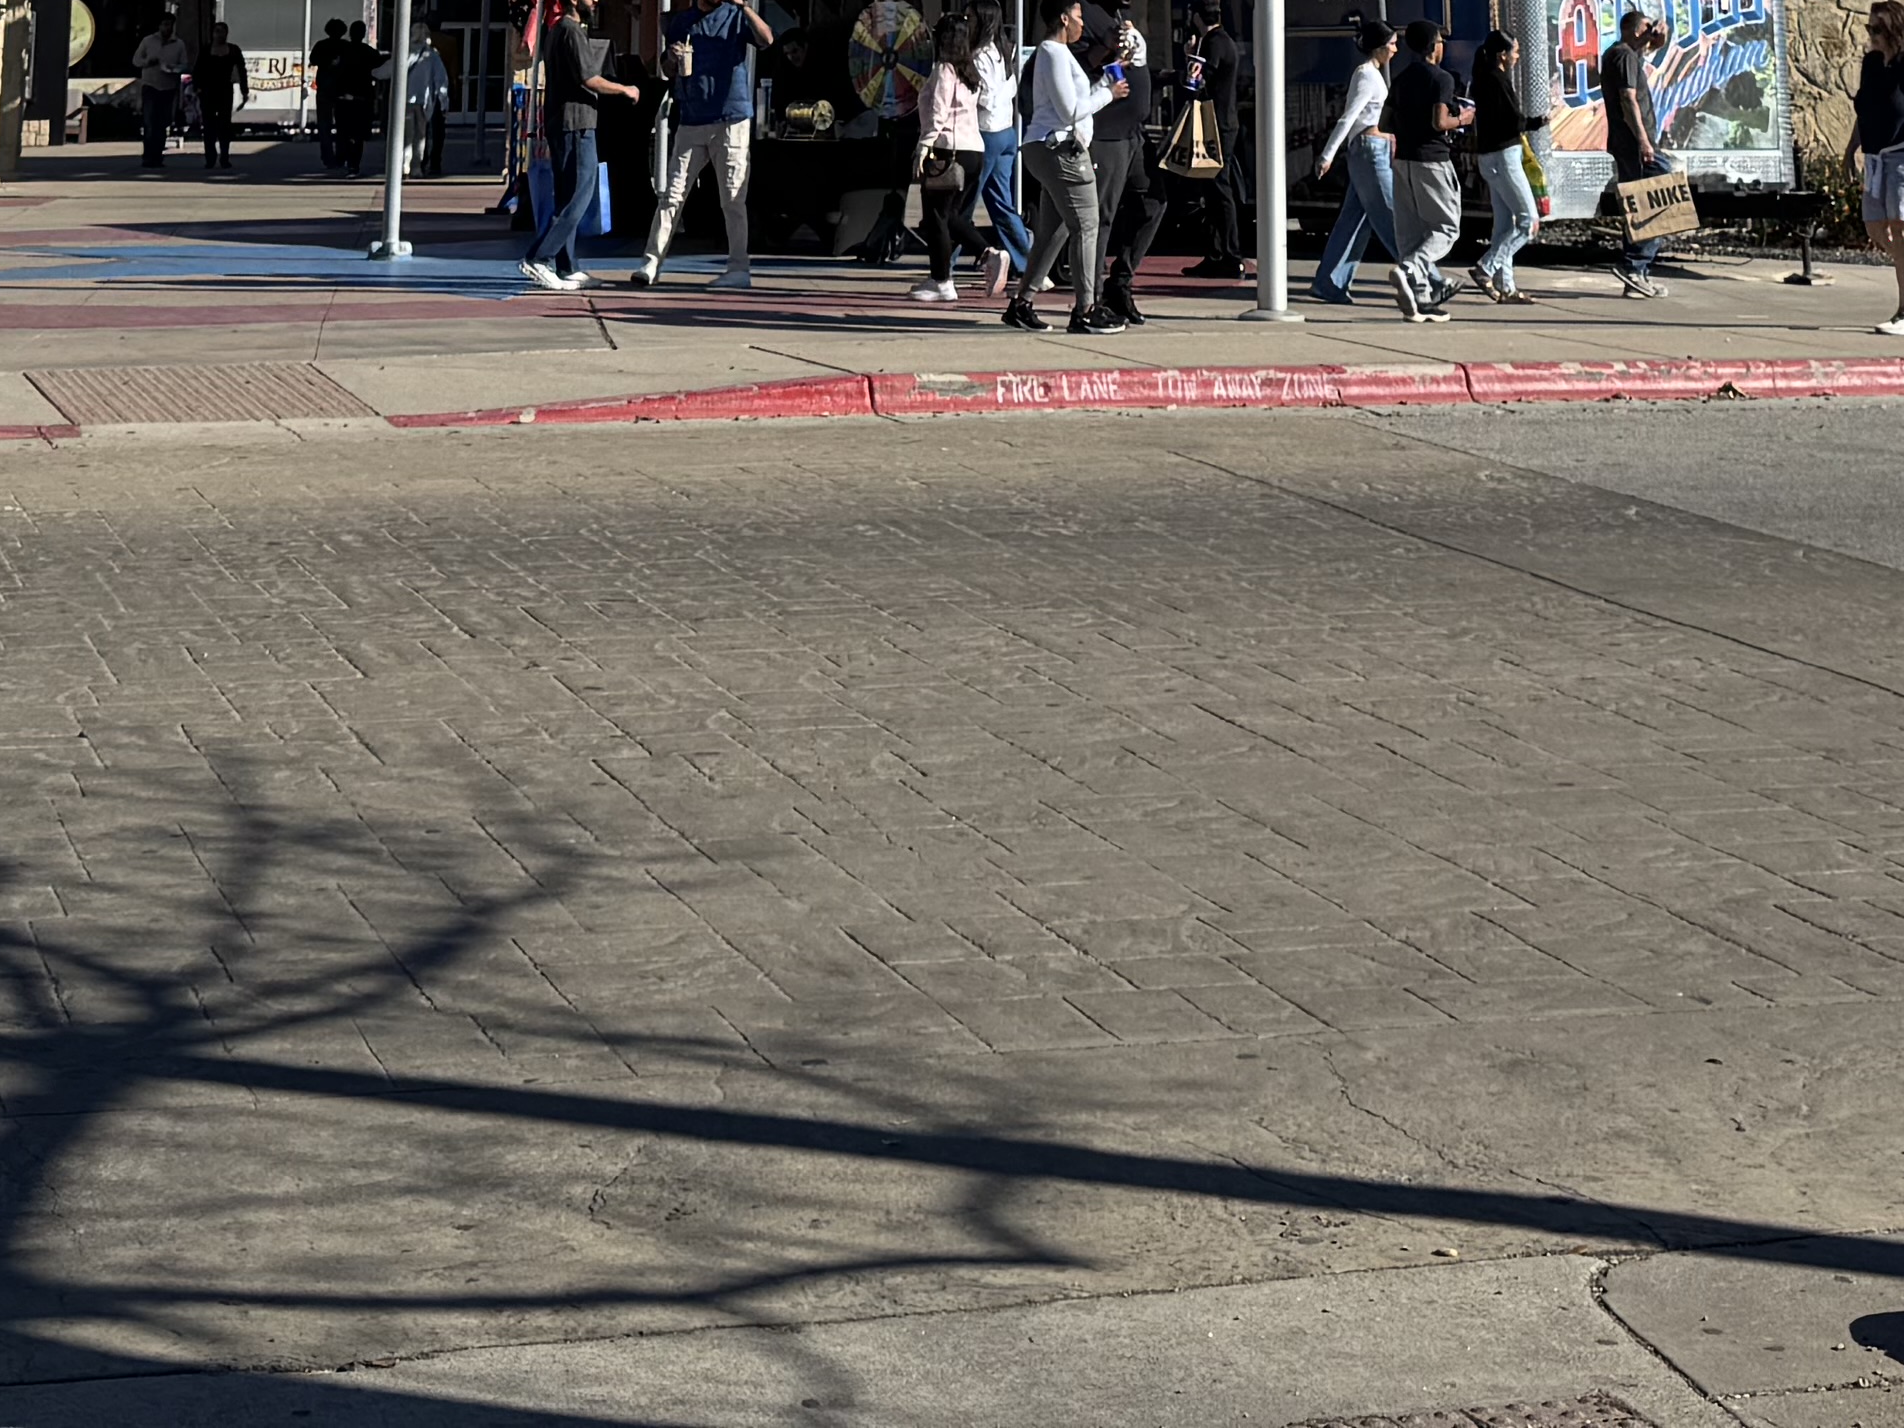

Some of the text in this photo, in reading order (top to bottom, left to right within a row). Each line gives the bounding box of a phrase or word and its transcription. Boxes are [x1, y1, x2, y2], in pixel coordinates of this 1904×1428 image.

[1652, 32, 1770, 143] yndham
[1646, 184, 1691, 210] NIKE
[996, 371, 1339, 404] FIRE LANE TOW AWAY ZONE
